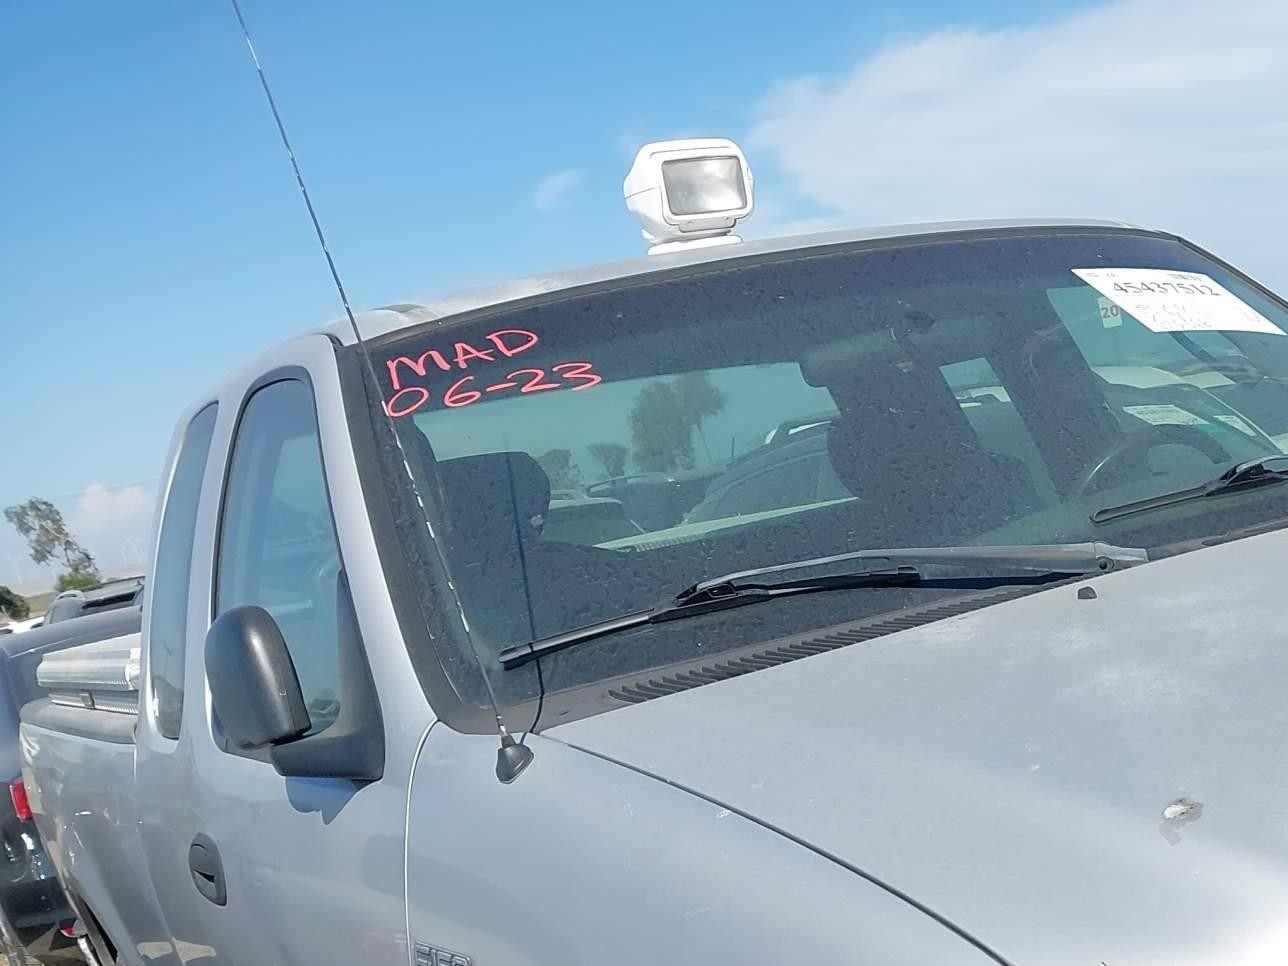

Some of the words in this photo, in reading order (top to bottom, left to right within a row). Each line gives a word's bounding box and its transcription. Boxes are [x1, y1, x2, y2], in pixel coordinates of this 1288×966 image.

[1112, 281, 1221, 298] 45437512
[1101, 304, 1119, 320] 20
[386, 329, 539, 390] MAD
[387, 362, 602, 417] 06-23
